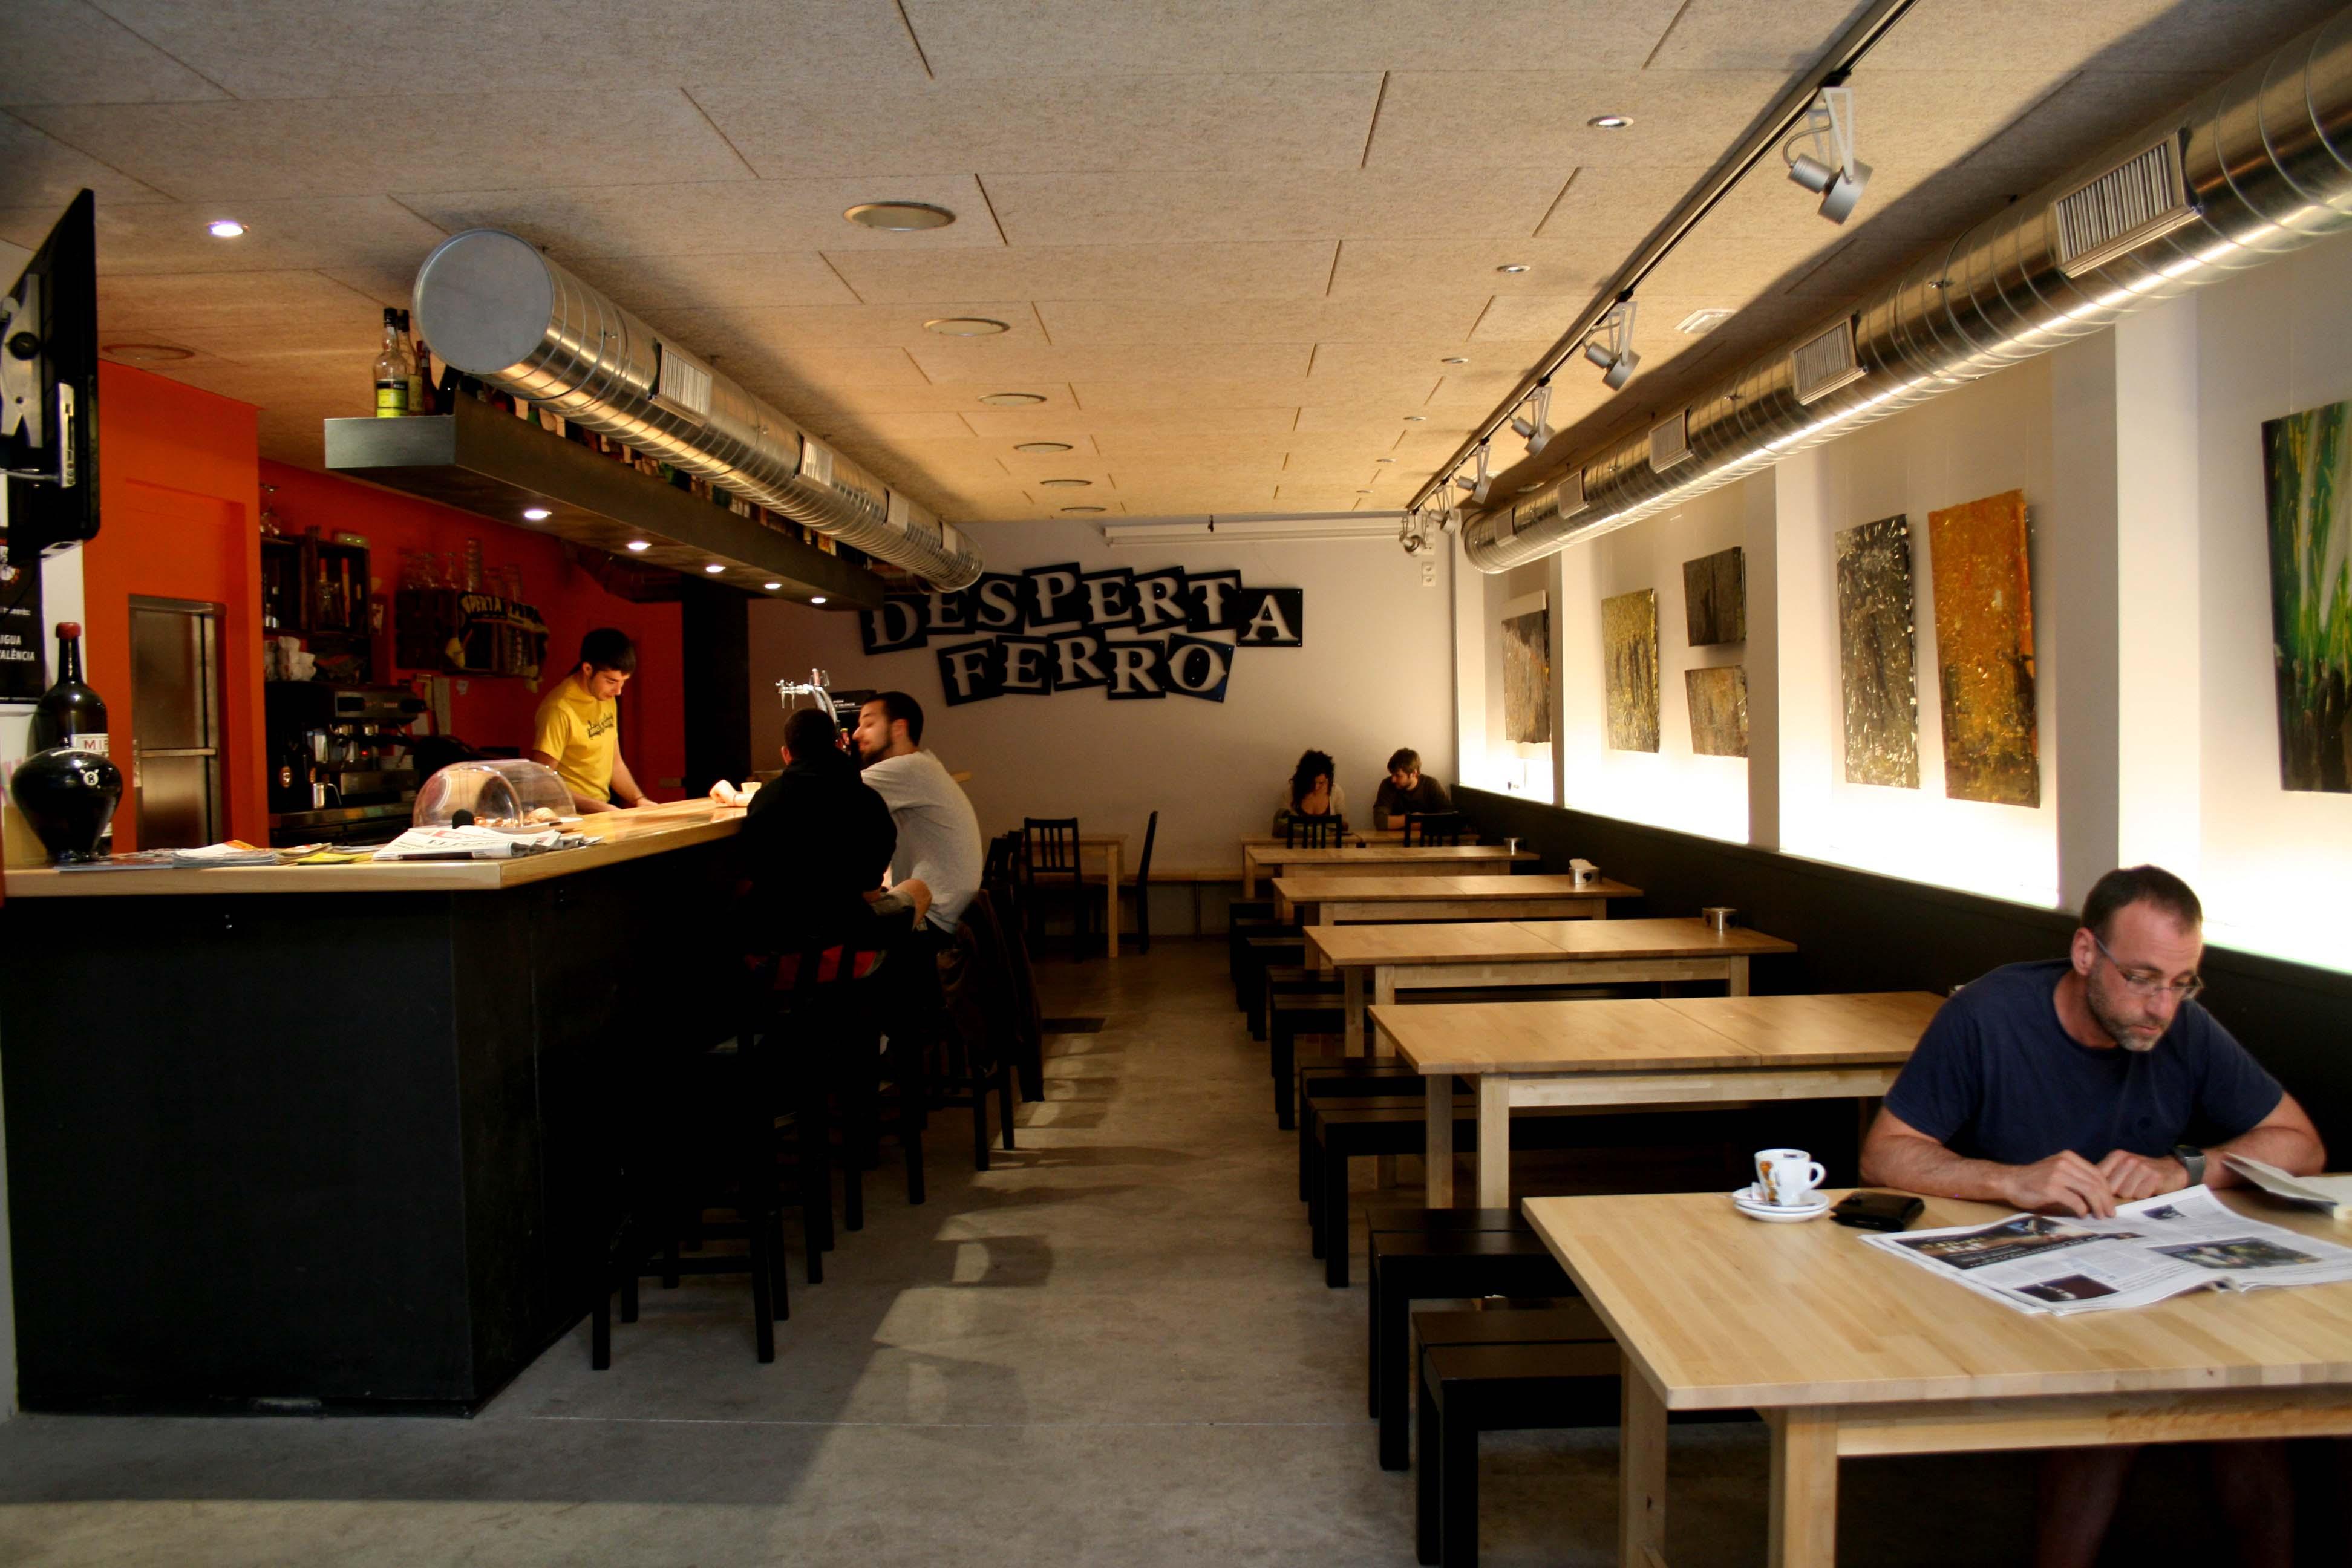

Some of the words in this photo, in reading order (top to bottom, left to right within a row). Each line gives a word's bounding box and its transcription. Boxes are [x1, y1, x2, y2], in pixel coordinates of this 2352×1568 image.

[0, 634, 22, 645] IGUA
[867, 571, 1299, 647] DESPERTA
[946, 635, 1227, 697] FERRO
